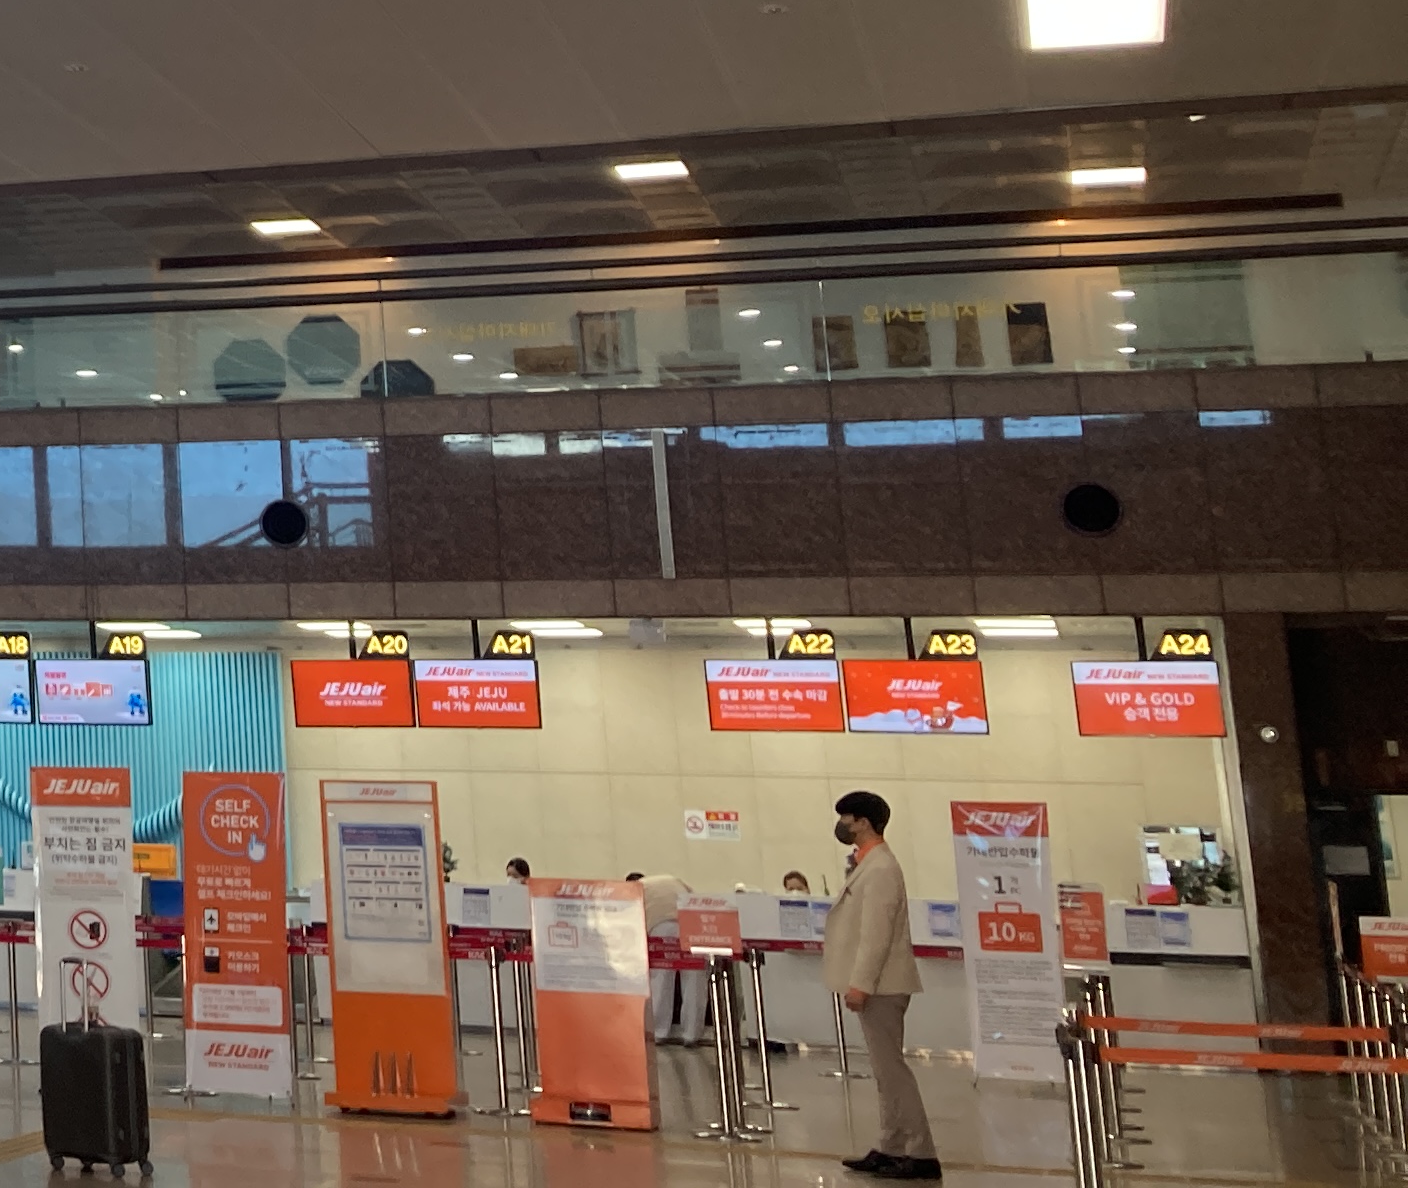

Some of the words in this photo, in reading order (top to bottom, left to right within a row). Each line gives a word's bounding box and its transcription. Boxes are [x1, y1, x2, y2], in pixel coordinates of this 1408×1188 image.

[109, 636, 143, 654] A19
[367, 636, 407, 655] A20
[492, 635, 531, 654] A21
[788, 634, 834, 654] A22
[929, 634, 976, 655] A23
[1160, 634, 1211, 655] A24
[319, 682, 386, 696] JEJUair
[888, 678, 943, 691] JEJUair
[476, 688, 507, 699] JEJU
[1105, 692, 1130, 705] VIP
[1135, 693, 1147, 705] &
[1150, 692, 1195, 705] GOLD
[474, 702, 525, 712] AVAILABLE
[43, 779, 120, 795] JEJUair
[215, 799, 251, 813] SELF
[211, 815, 259, 829] CHECK
[44, 837, 81, 851] 부치는
[86, 837, 97, 851] 짐
[102, 838, 126, 852] 금지
[227, 831, 243, 844] IN
[994, 876, 1006, 894] 1
[988, 922, 1016, 942] 10
[1019, 932, 1035, 943] KG
[204, 1042, 274, 1059] JEJUair
